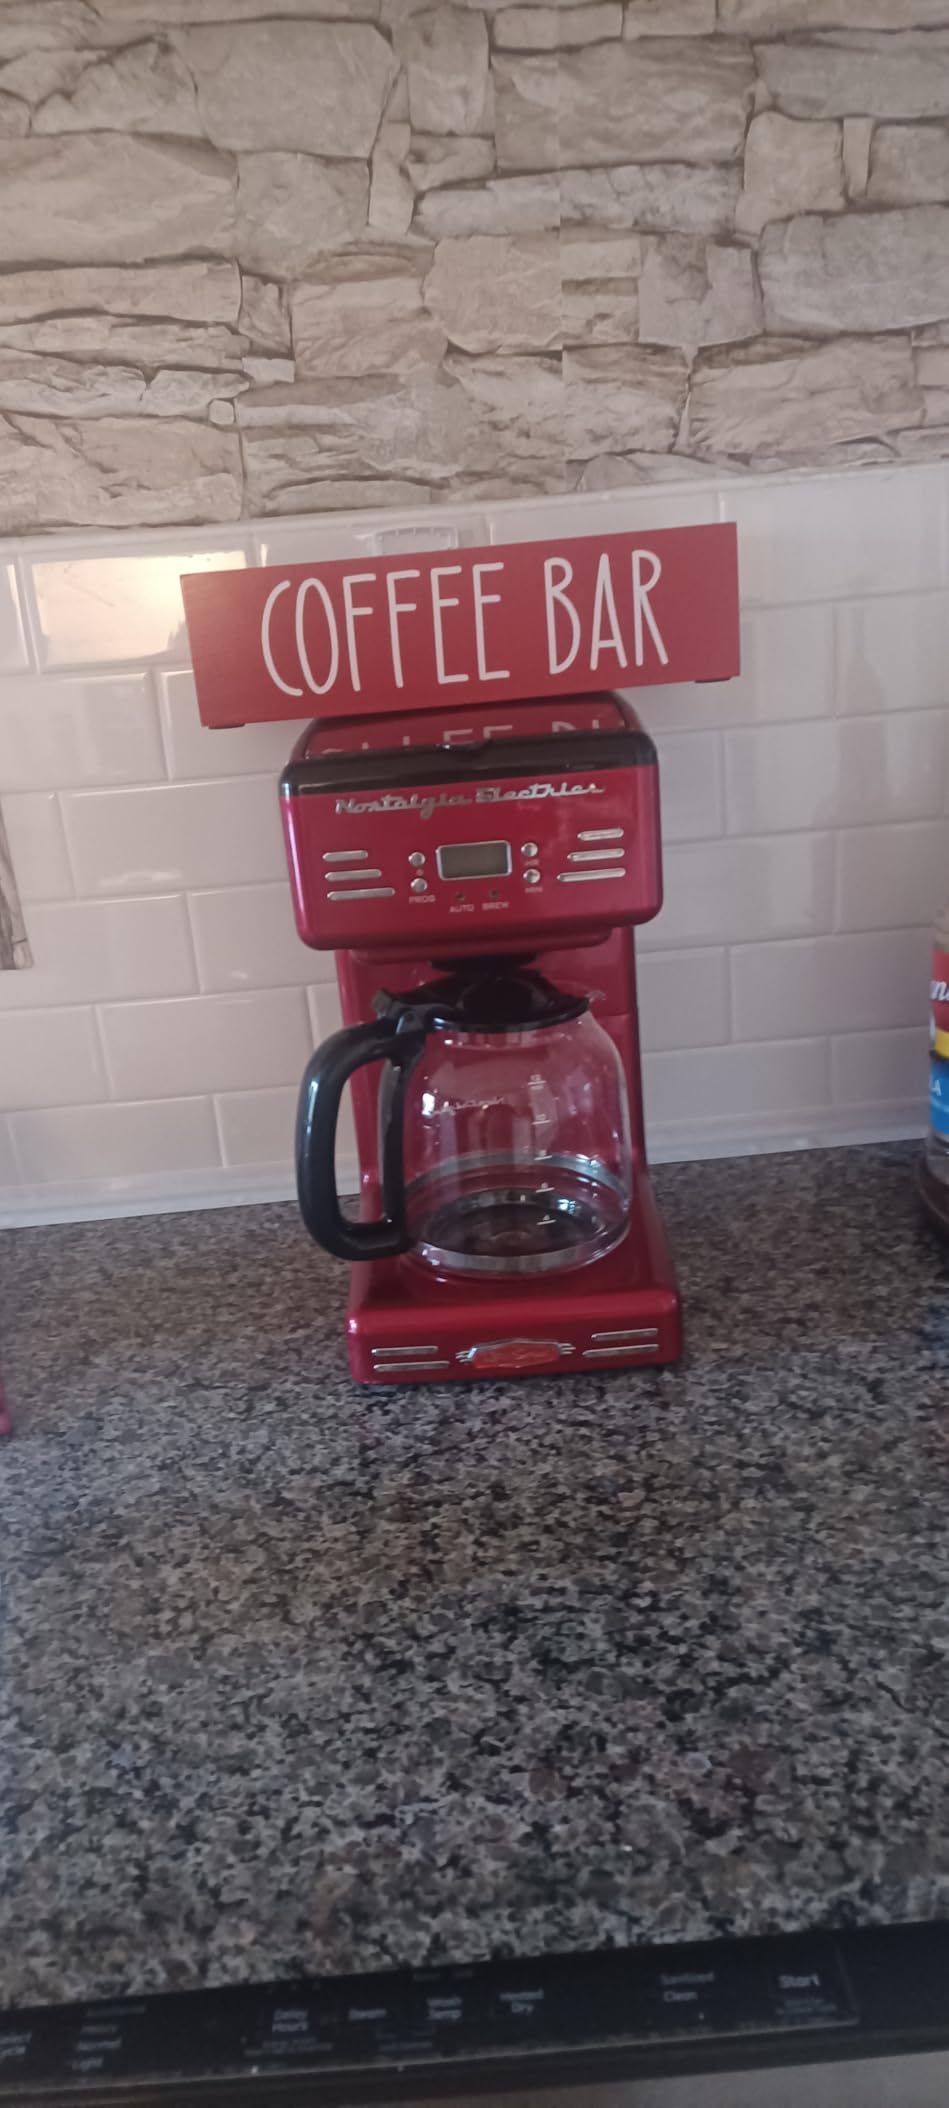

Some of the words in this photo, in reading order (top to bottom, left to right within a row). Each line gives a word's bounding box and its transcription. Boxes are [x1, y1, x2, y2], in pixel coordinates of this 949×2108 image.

[261, 562, 510, 697] COFFEE
[543, 549, 669, 675] BAR
[335, 791, 472, 820] Nostalgia
[475, 781, 605, 804] Electrics
[449, 903, 475, 913] AUTO
[778, 1973, 820, 1989] Start
